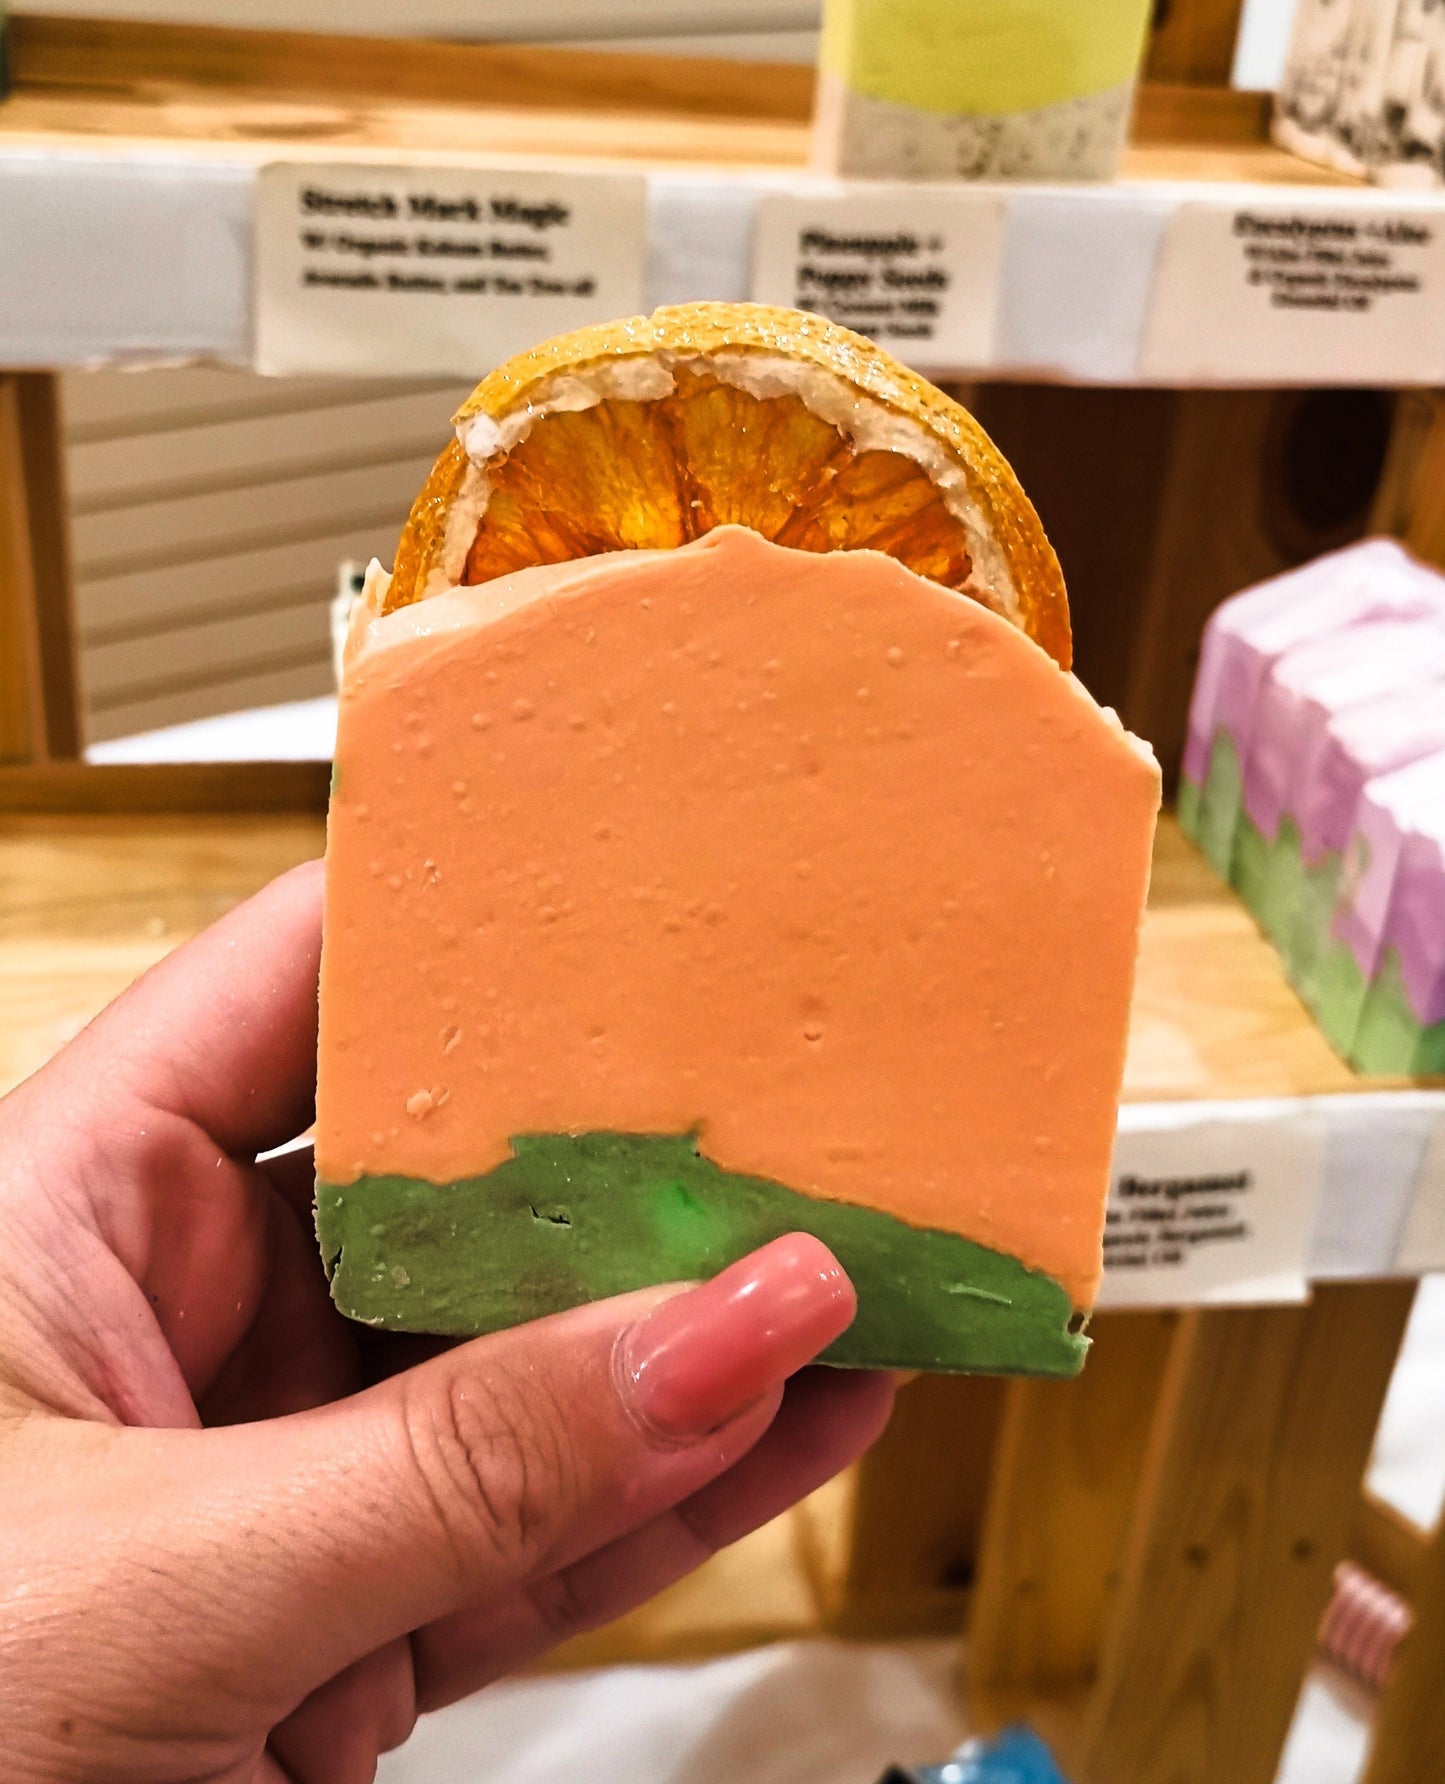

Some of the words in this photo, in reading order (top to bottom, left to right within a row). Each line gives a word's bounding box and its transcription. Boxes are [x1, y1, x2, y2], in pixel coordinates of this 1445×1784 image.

[302, 187, 397, 219] Stretch
[407, 192, 478, 221] Mark
[490, 192, 570, 229] Magic
[336, 235, 409, 258] Organic
[800, 229, 918, 259] Pineapple
[454, 276, 487, 294] and
[530, 277, 568, 296] Tree
[798, 265, 870, 297] Poppy
[882, 266, 948, 291] Seeds
[1118, 1169, 1250, 1200] Bergamot
